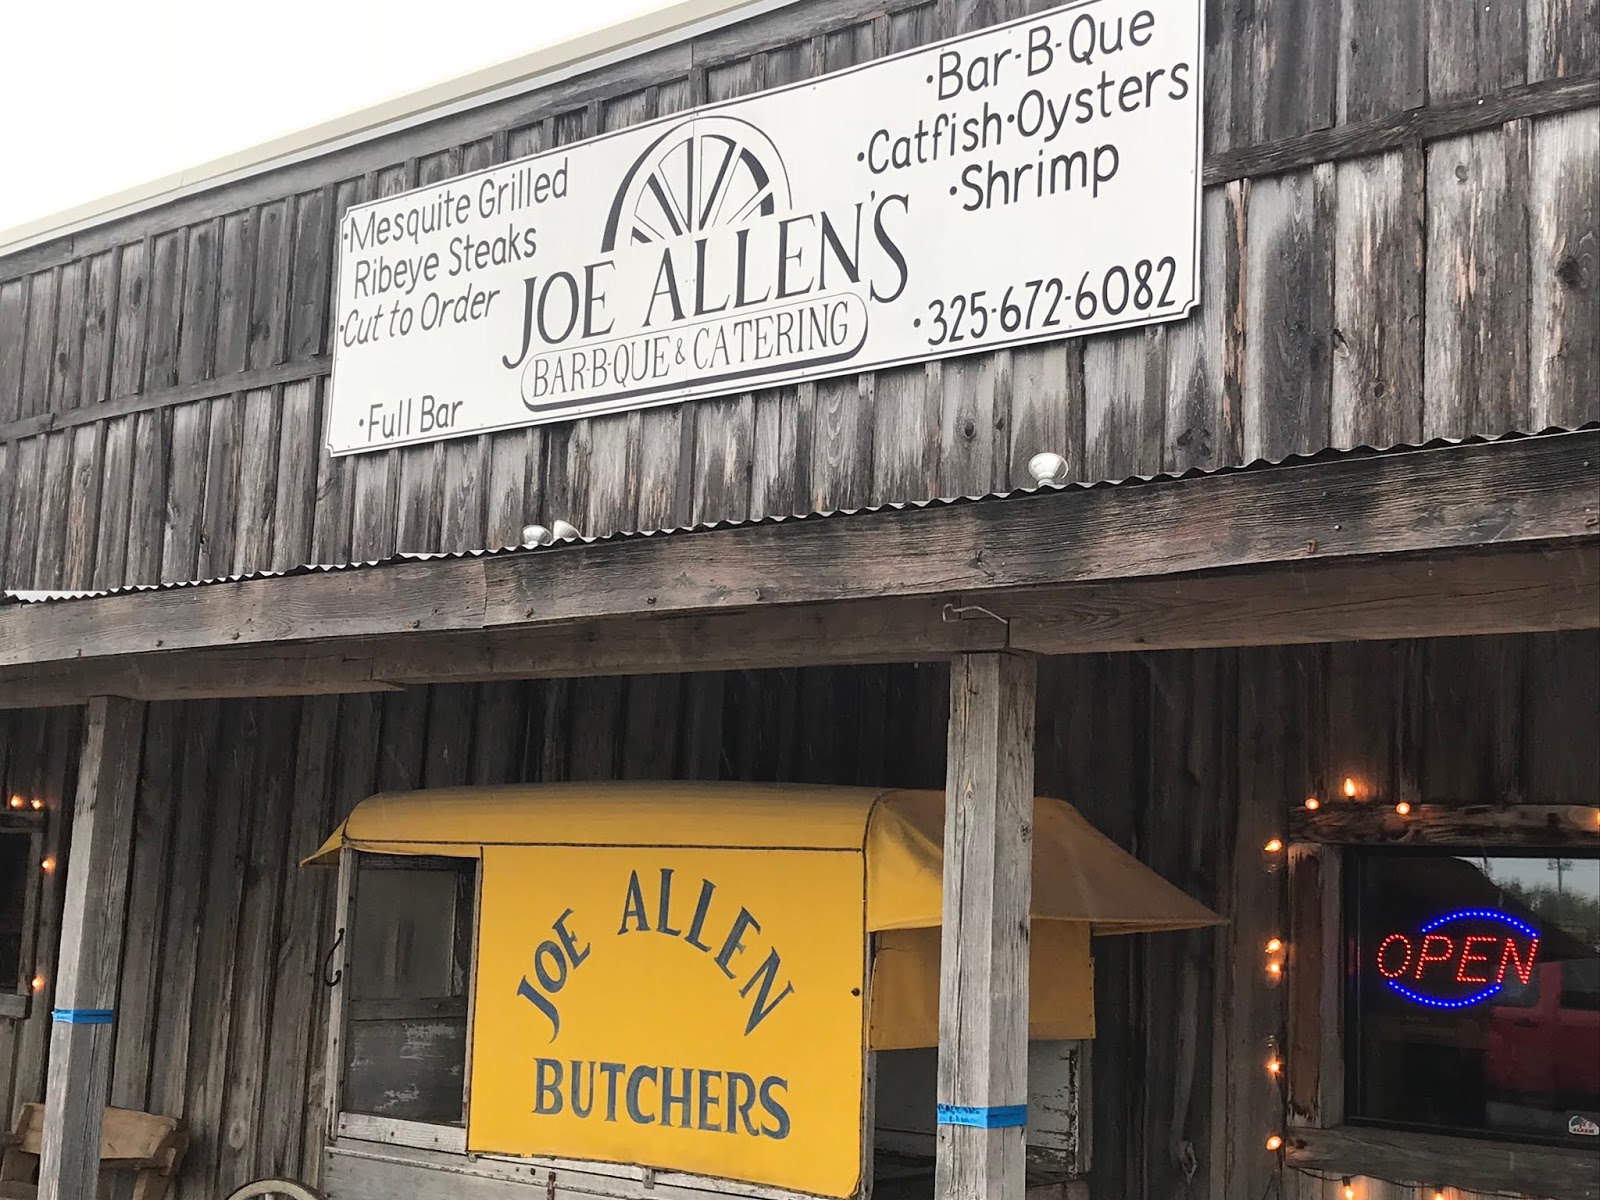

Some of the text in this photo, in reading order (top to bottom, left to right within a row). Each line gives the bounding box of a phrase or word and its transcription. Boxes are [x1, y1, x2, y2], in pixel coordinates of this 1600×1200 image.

[478, 156, 568, 219] Grilled
[354, 223, 537, 299] Ribeye Steaks
[502, 190, 911, 370] JOE ALLEN'S
[389, 299, 413, 336] to
[420, 283, 500, 331] Order
[532, 300, 850, 399] BAR-B-QUE & CATERING
[420, 394, 464, 433] Bar
[516, 868, 795, 1044] JOE ALLEN
[1376, 932, 1541, 986] OPEN
[531, 1057, 791, 1140] BUTCHERS
